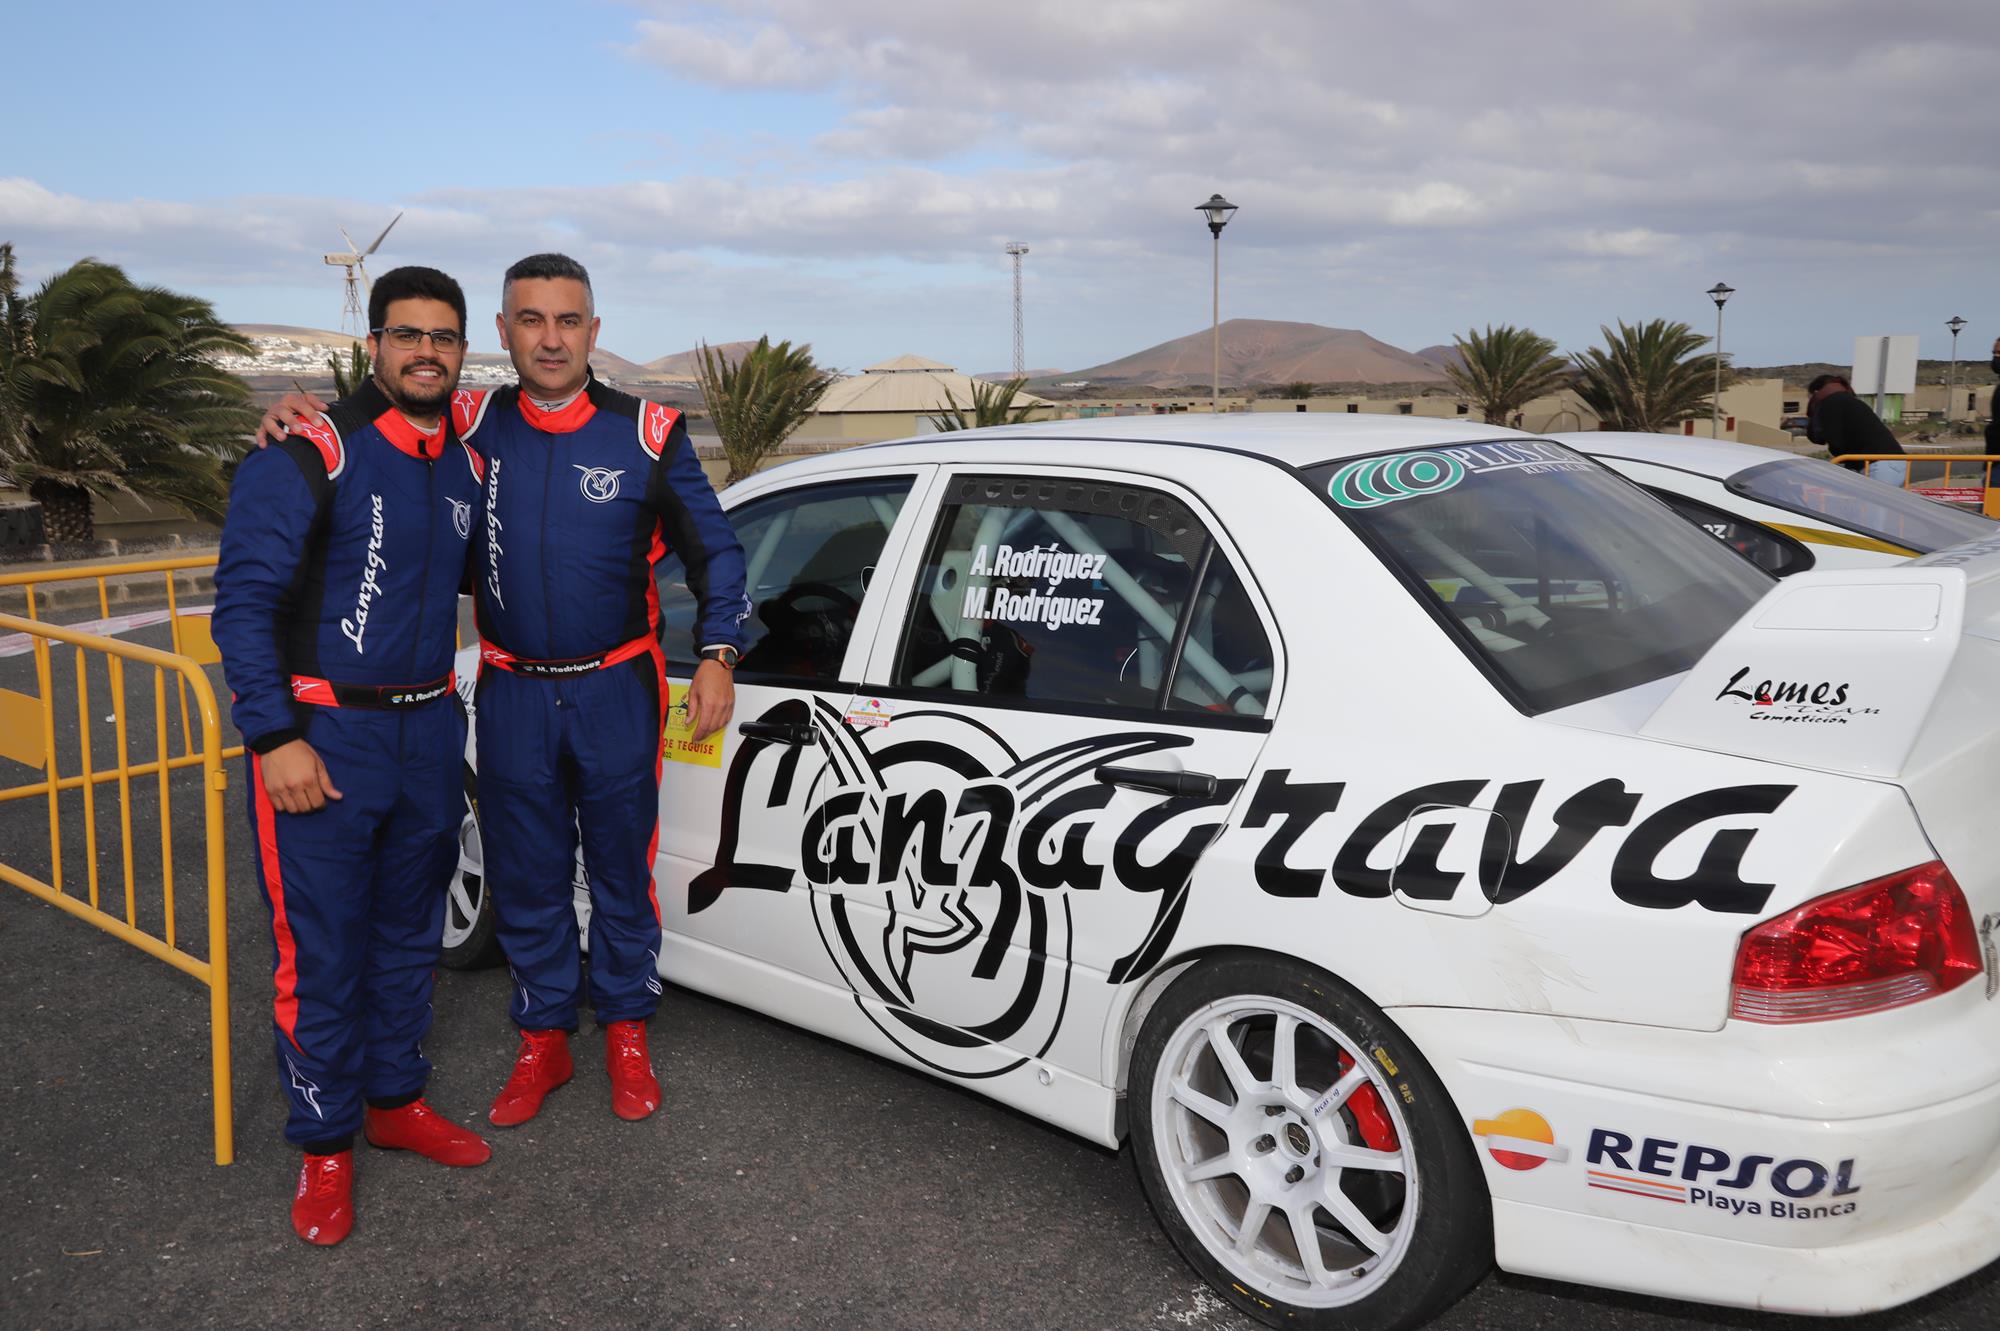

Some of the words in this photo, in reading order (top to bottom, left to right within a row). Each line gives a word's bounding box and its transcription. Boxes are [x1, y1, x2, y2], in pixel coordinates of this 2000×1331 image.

[486, 456, 505, 611] Lanzagrava
[340, 493, 387, 655] Lanzagrava
[969, 543, 1107, 586] A.Rodríguez
[962, 586, 1105, 631] M.Rodríguez
[1715, 666, 1849, 706] Lemes
[678, 740, 714, 755] TEGUISE
[1586, 1128, 1861, 1198] REPSOL
[1690, 1188, 1762, 1216] Playa
[1771, 1200, 1857, 1219] Blanca
